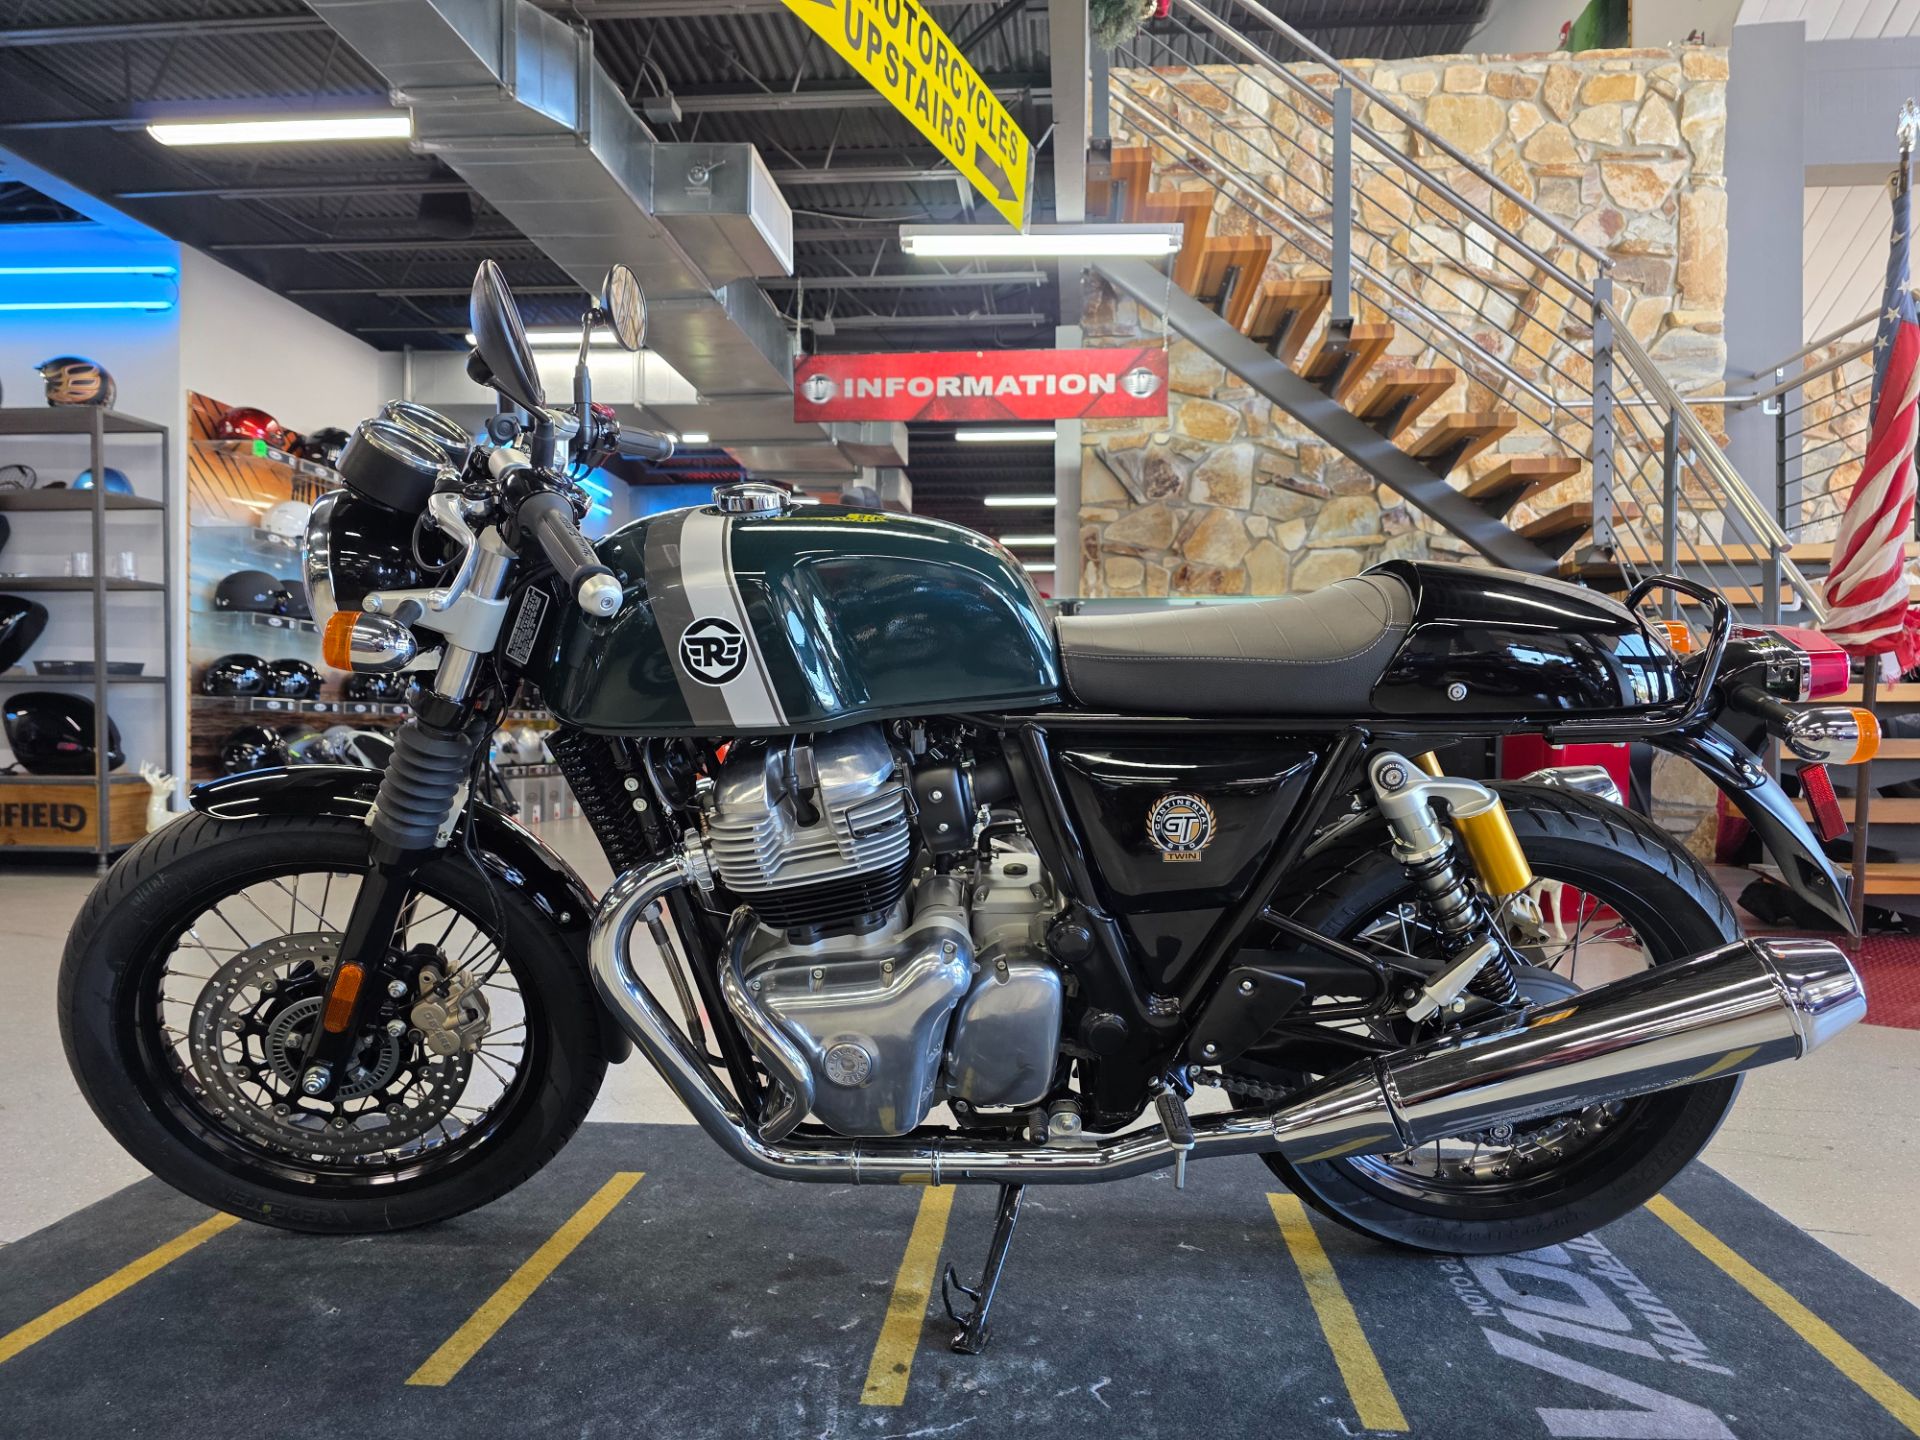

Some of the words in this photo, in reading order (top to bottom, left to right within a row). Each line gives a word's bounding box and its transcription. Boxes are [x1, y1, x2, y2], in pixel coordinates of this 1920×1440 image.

[845, 0, 967, 157] UPSTAIRS
[868, 0, 1018, 166] OTORCYCLES
[844, 373, 1116, 398] INFORMATION
[0, 803, 87, 832] FIELD
[1155, 799, 1208, 830] CONTINENTAL
[1162, 813, 1200, 843] GT
[1563, 1232, 1735, 1376] Mandell
